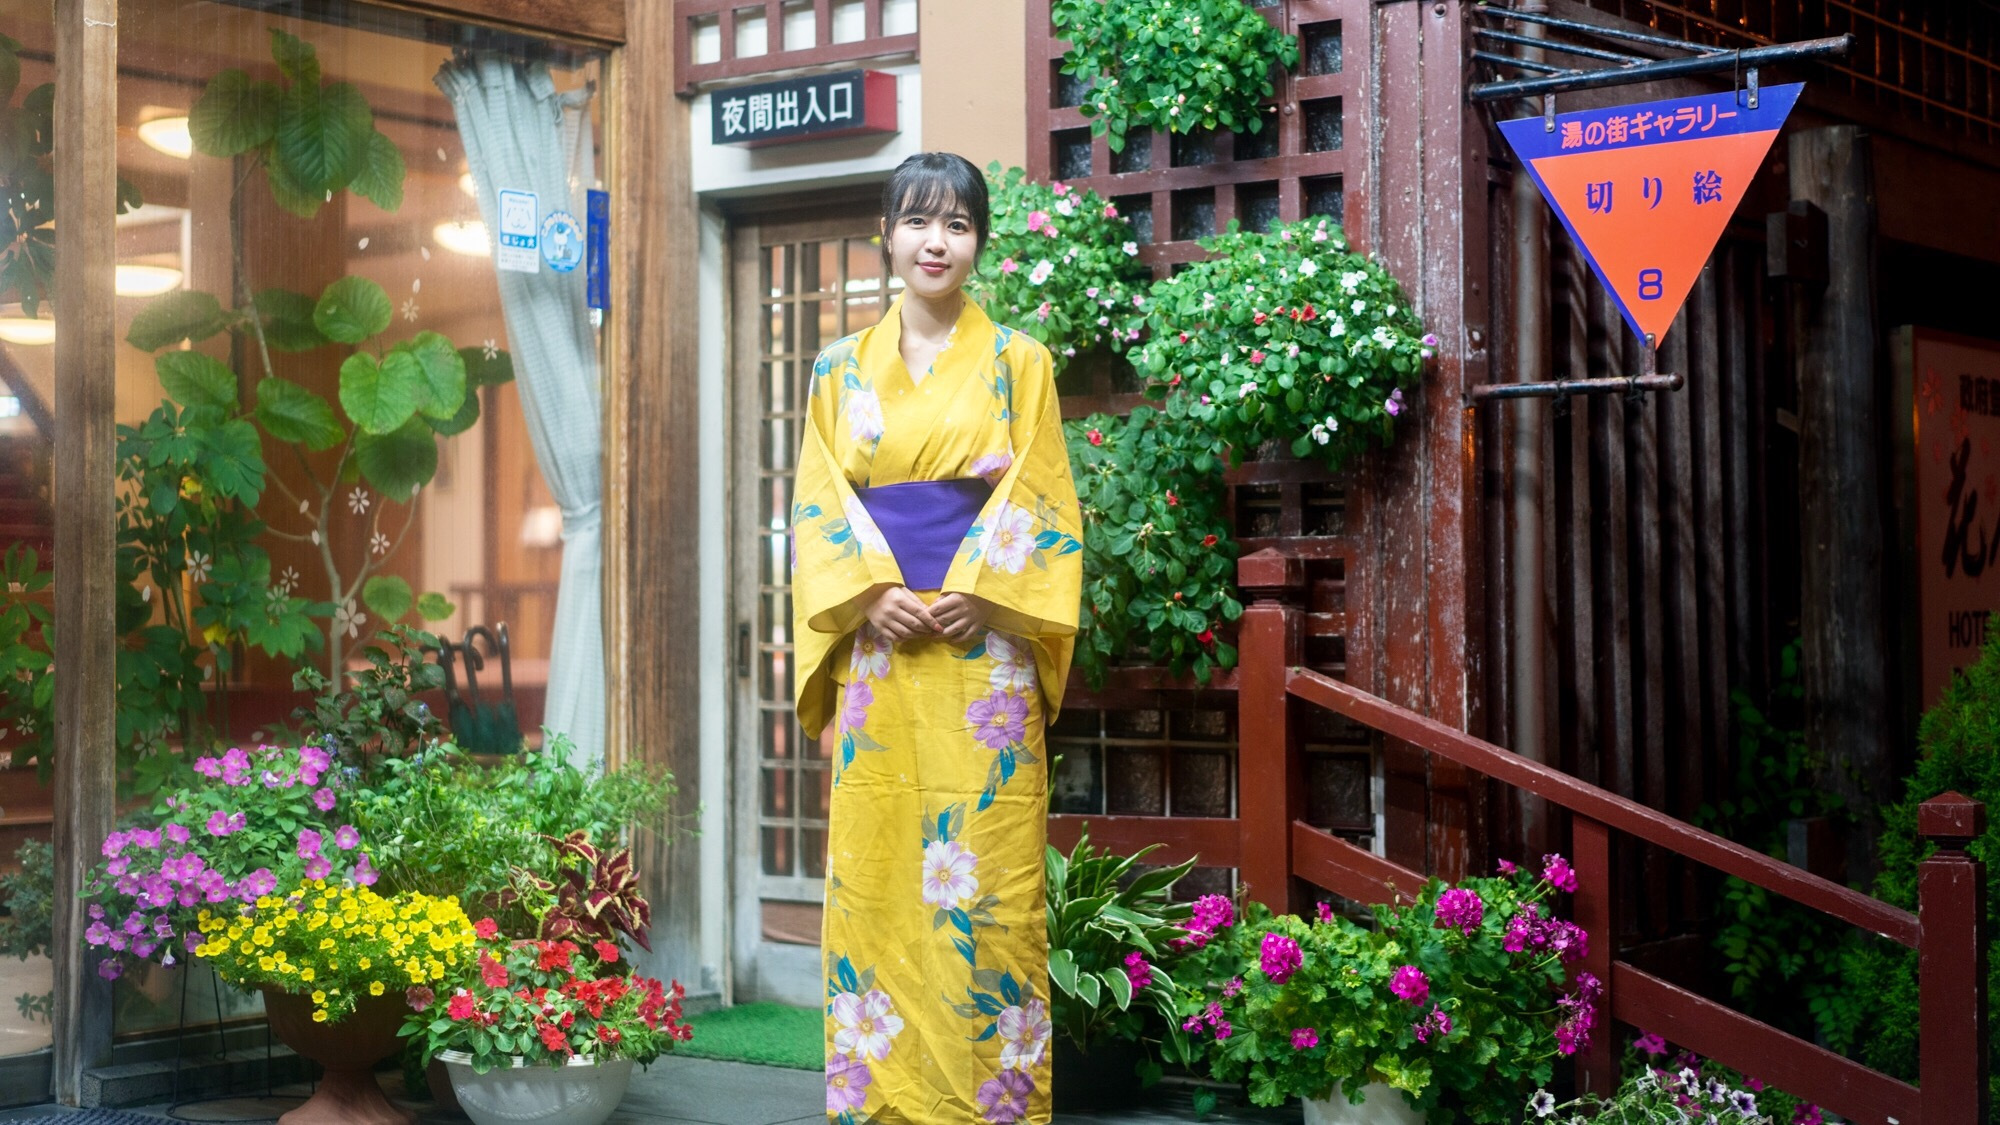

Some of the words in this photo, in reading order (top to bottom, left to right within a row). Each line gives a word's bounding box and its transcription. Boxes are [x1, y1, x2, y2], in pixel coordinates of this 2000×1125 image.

[721, 81, 853, 137] 夜間出入口
[1560, 103, 1737, 150] 湯の街ギャラリー
[1585, 170, 1723, 215] 切り絵
[1637, 268, 1663, 301] 8
[1942, 437, 2000, 580] 花
